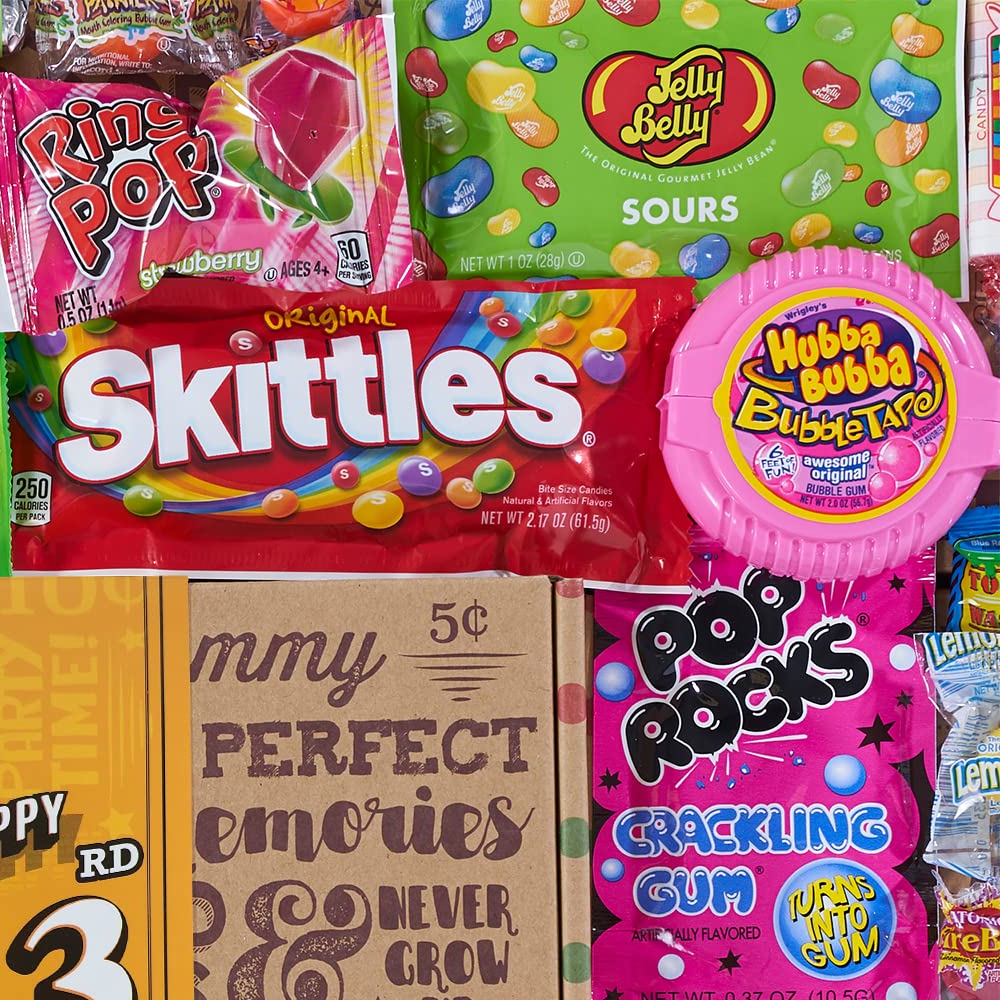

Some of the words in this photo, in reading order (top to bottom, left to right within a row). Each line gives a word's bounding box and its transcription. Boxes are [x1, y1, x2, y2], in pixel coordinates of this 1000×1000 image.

[648, 59, 724, 105] Jelly
[602, 158, 654, 183] ORIGINAL
[657, 172, 712, 184] GOURMET
[715, 163, 745, 182] JELLY
[622, 195, 738, 226] SOURS
[281, 261, 310, 278] AGES
[312, 263, 329, 277] 4+
[338, 239, 361, 259] 60
[784, 302, 827, 321] Wrigley's
[765, 318, 881, 374] Hubba
[800, 345, 911, 404] Bubba
[56, 331, 583, 483] Skittles
[803, 451, 870, 468] awesome
[811, 467, 868, 483] original
[14, 502, 49, 512] CALORIES
[15, 478, 49, 501] 250
[806, 484, 842, 496] BUBBLE
[845, 484, 867, 496] GUM
[481, 511, 503, 524] NET
[507, 511, 524, 524] WT
[527, 512, 549, 527] 2.17
[553, 513, 567, 527] OZ
[570, 513, 610, 533] (61.5g)
[430, 598, 489, 644] 5¢
[634, 566, 806, 692] POP
[190, 630, 387, 707] mmy
[621, 618, 873, 785] ROCKS
[201, 716, 538, 779] PERFECT
[195, 786, 535, 863] emories
[614, 804, 890, 856] CRACKLING
[79, 842, 140, 879] RD
[378, 884, 518, 936] NEVER
[635, 867, 756, 916] GUM
[789, 875, 876, 921] TURNS
[804, 901, 868, 945] INTO
[385, 940, 509, 993] GROW
[801, 927, 880, 968] GUM
